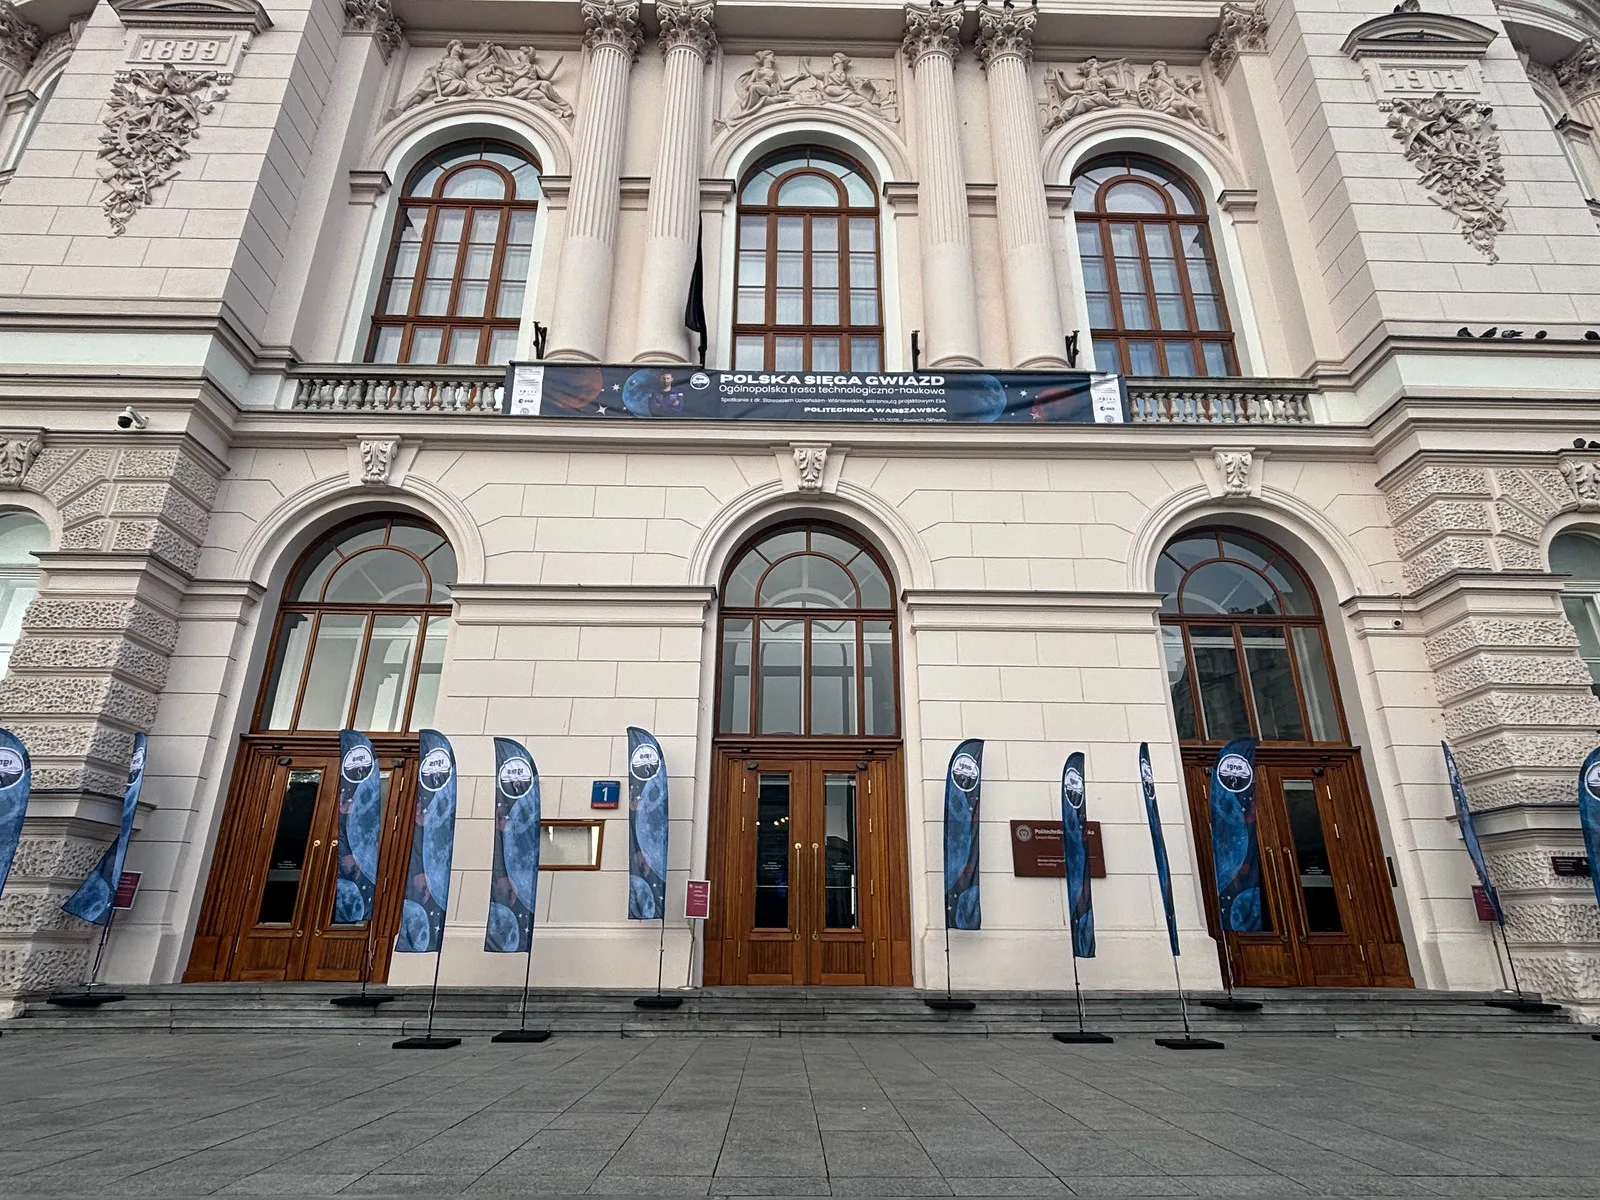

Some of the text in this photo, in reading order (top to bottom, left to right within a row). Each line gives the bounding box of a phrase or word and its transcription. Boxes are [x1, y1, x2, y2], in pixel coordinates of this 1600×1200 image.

[141, 40, 220, 60] 1899
[1389, 68, 1463, 89] 1901
[720, 374, 945, 386] POLSKA SIĘGA GWIAZD
[719, 384, 788, 394] Ogólnopolska
[818, 386, 945, 396] technologiczno-naukowa
[602, 786, 608, 801] 1
